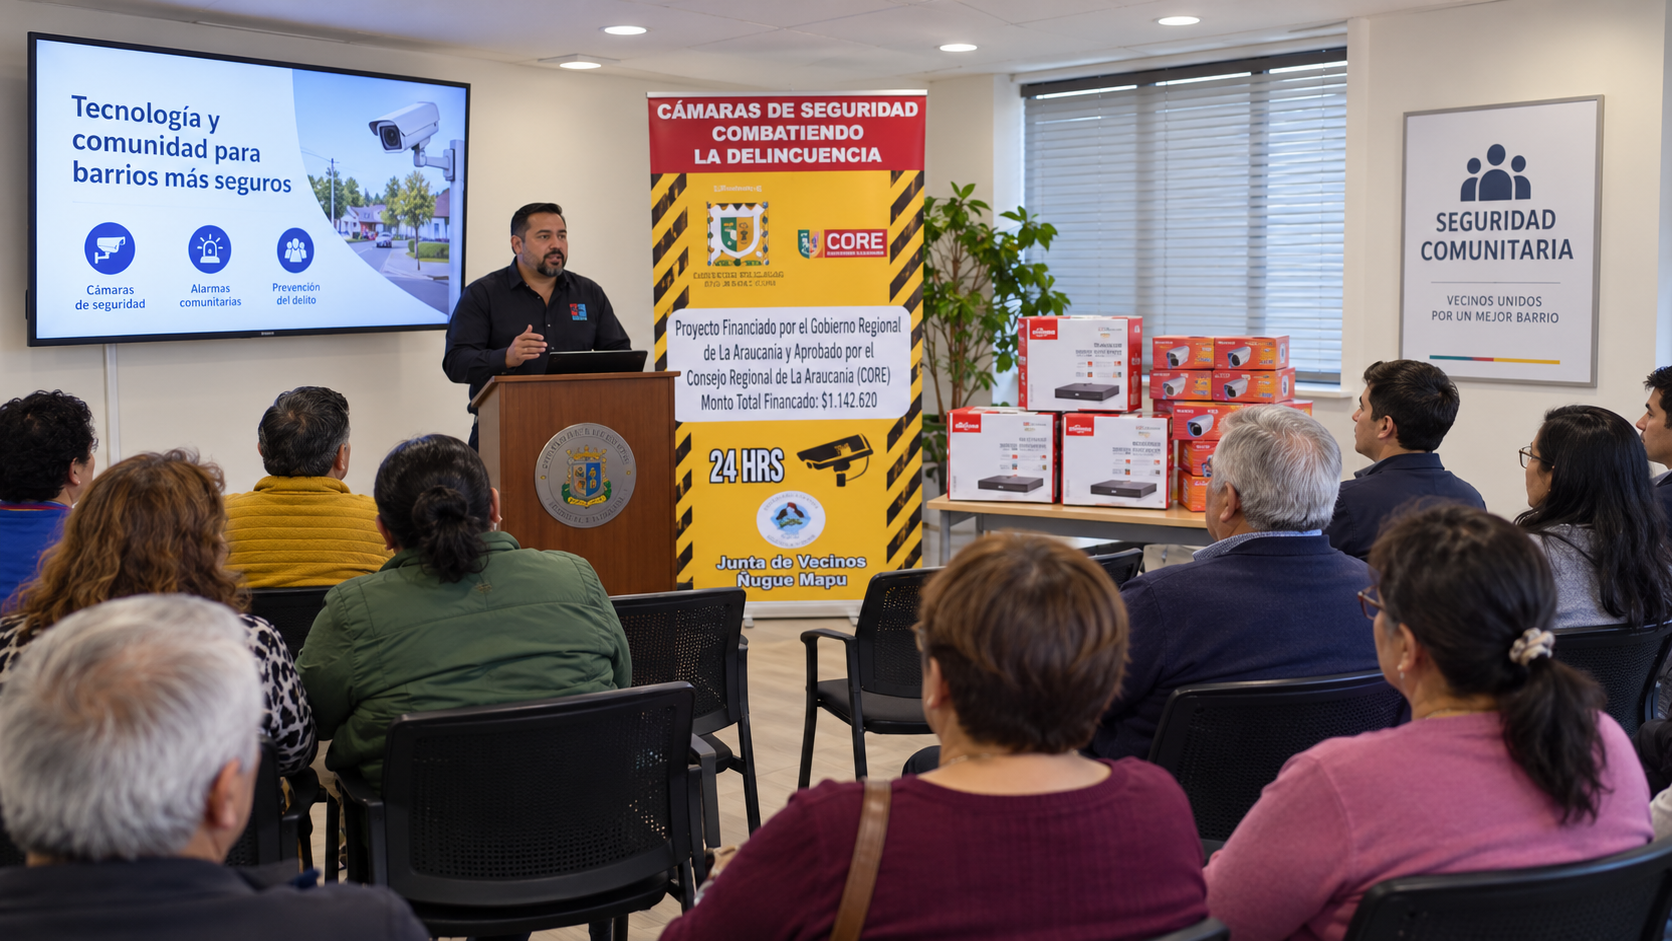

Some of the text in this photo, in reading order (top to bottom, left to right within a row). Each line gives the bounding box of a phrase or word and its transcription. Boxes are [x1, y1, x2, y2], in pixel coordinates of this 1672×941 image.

[71, 94, 220, 134] Tecnología y
[657, 100, 918, 119] CÁMARAS DE SEGURIDAD
[712, 125, 863, 141] COMBATIENDO
[72, 133, 260, 163] comunidad para
[694, 147, 882, 164] LA DELINCUENCIA
[73, 161, 291, 196] barrios más seguros
[1436, 209, 1556, 232] SEGURIDAD
[827, 233, 883, 250] CORE
[1421, 238, 1574, 261] COMUNITARIA
[87, 283, 134, 296] Cámaras
[191, 283, 230, 294] Alarmas
[272, 282, 320, 293] Prevención
[75, 297, 145, 311] de seguridad
[180, 295, 241, 307] comunitarias
[277, 294, 316, 305] del delito
[1447, 296, 1542, 307] VECINOS UNIDOS
[1432, 310, 1559, 323] POR UN MEJOR BARRIO
[675, 316, 901, 340] Proyecto Financiado por el Gobierno Regional
[704, 344, 716, 361] de
[719, 344, 730, 360] La
[785, 347, 791, 363] y
[794, 342, 842, 363] Aprobado
[845, 344, 862, 362] por
[865, 342, 874, 358] el
[687, 370, 726, 389] Consejo
[729, 369, 772, 389] Regional
[775, 368, 787, 385] de
[790, 368, 801, 384] La
[857, 366, 890, 386] (CORE)
[701, 391, 877, 410] Monto Total Financado: $1.142.620
[709, 447, 784, 484] 24 HRS
[716, 554, 866, 570] Junta de Vecinos
[737, 571, 847, 590] Ñugue Mapu
